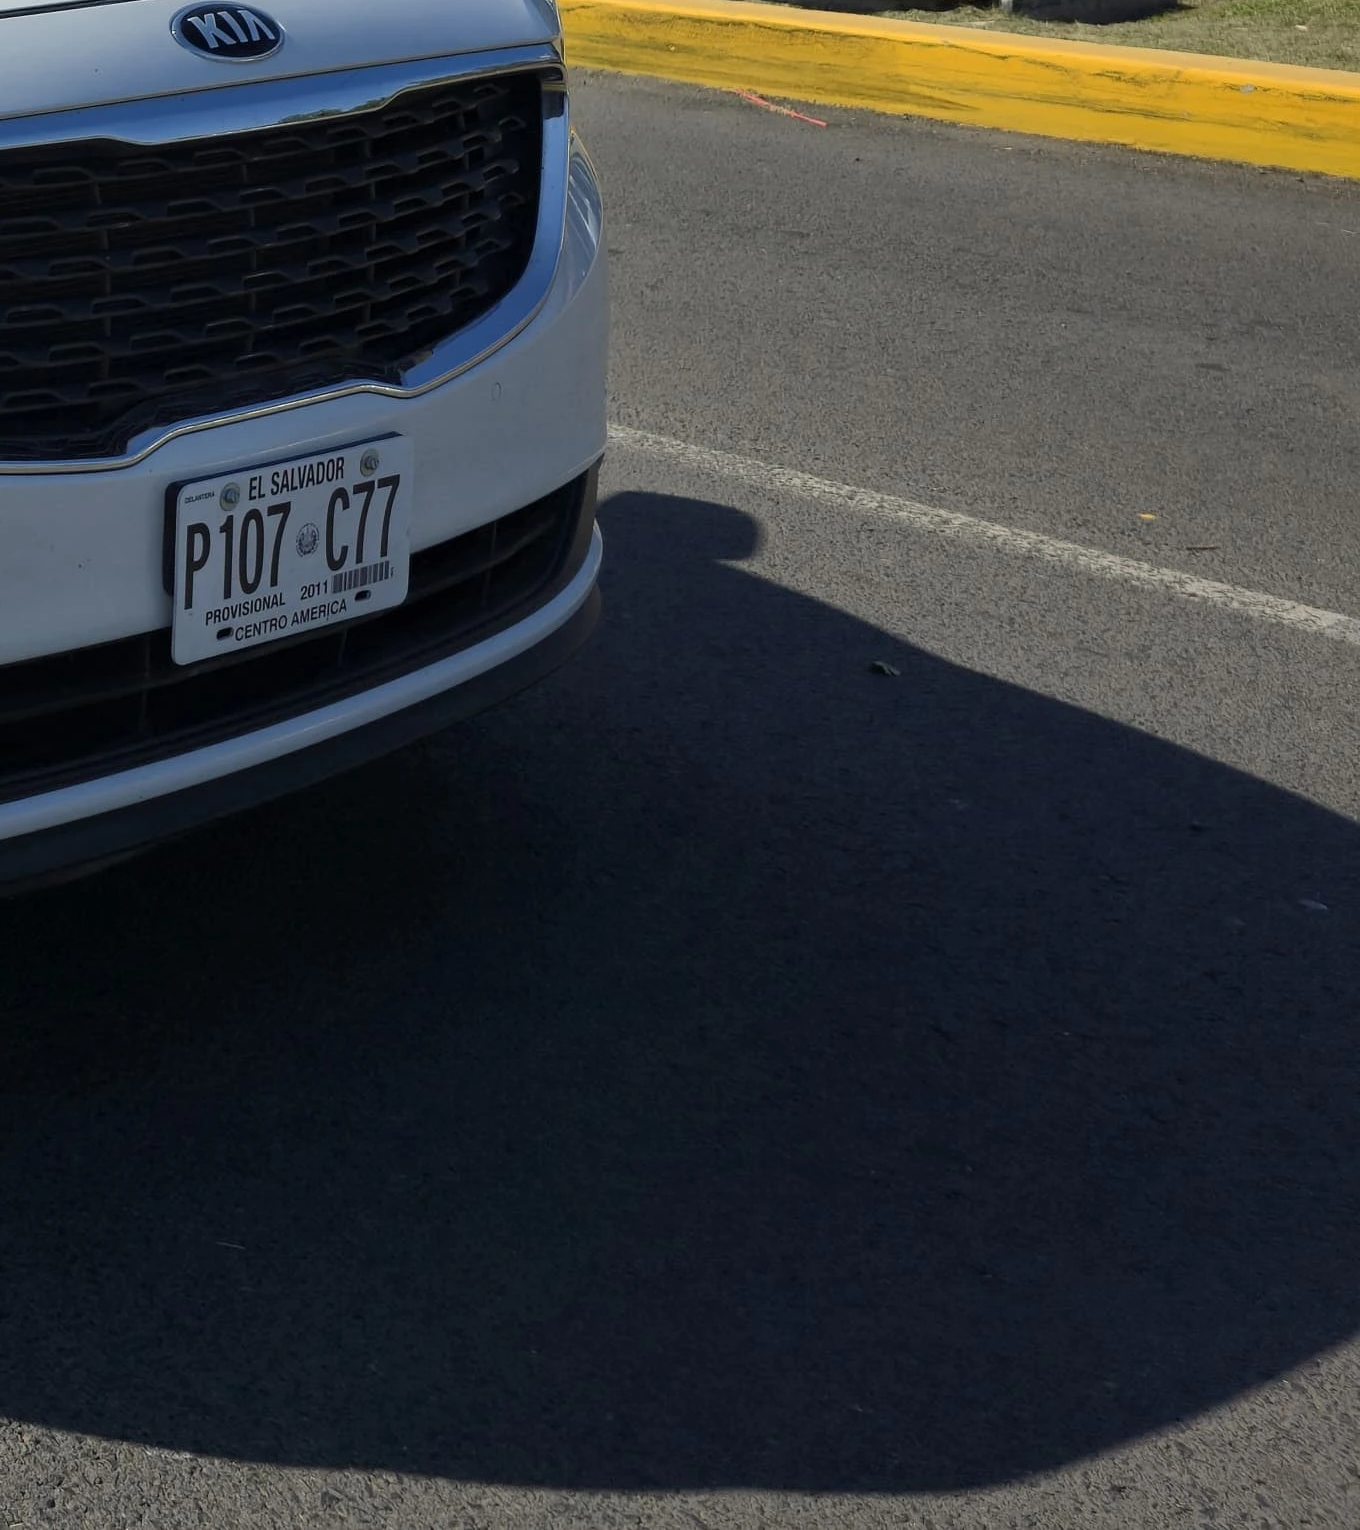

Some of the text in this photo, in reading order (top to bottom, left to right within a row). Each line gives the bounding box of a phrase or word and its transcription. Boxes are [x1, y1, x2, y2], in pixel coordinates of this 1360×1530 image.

[186, 9, 277, 50] KIA
[248, 456, 346, 501] EL SALVADOR
[183, 473, 401, 611] P107 C77
[204, 580, 329, 626] PROVISIONAL 2011
[234, 598, 348, 642] CENTRO AMERICA
